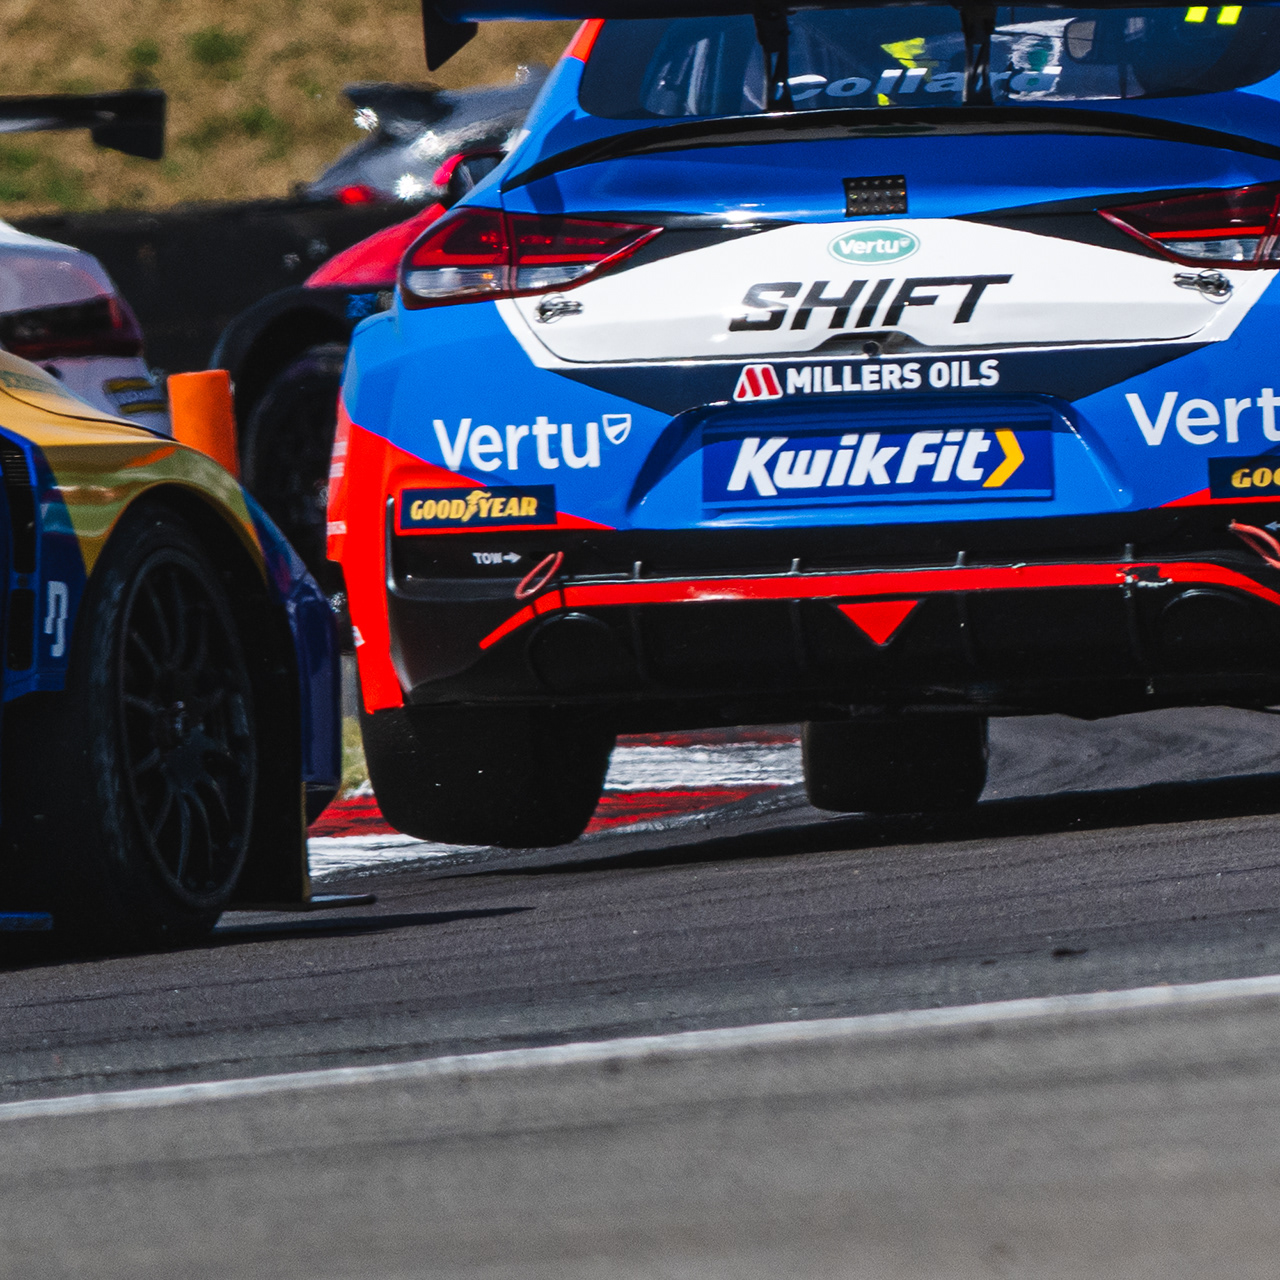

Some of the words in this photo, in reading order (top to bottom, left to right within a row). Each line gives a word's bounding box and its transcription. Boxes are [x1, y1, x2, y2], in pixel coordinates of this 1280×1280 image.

[839, 236, 901, 256] Vertu
[728, 274, 1012, 333] SHIFT
[786, 361, 921, 395] MILLERS
[929, 359, 1000, 389] OILS
[433, 415, 600, 472] Vertu
[727, 429, 993, 497] KwikFit
[472, 551, 502, 566] TOW
